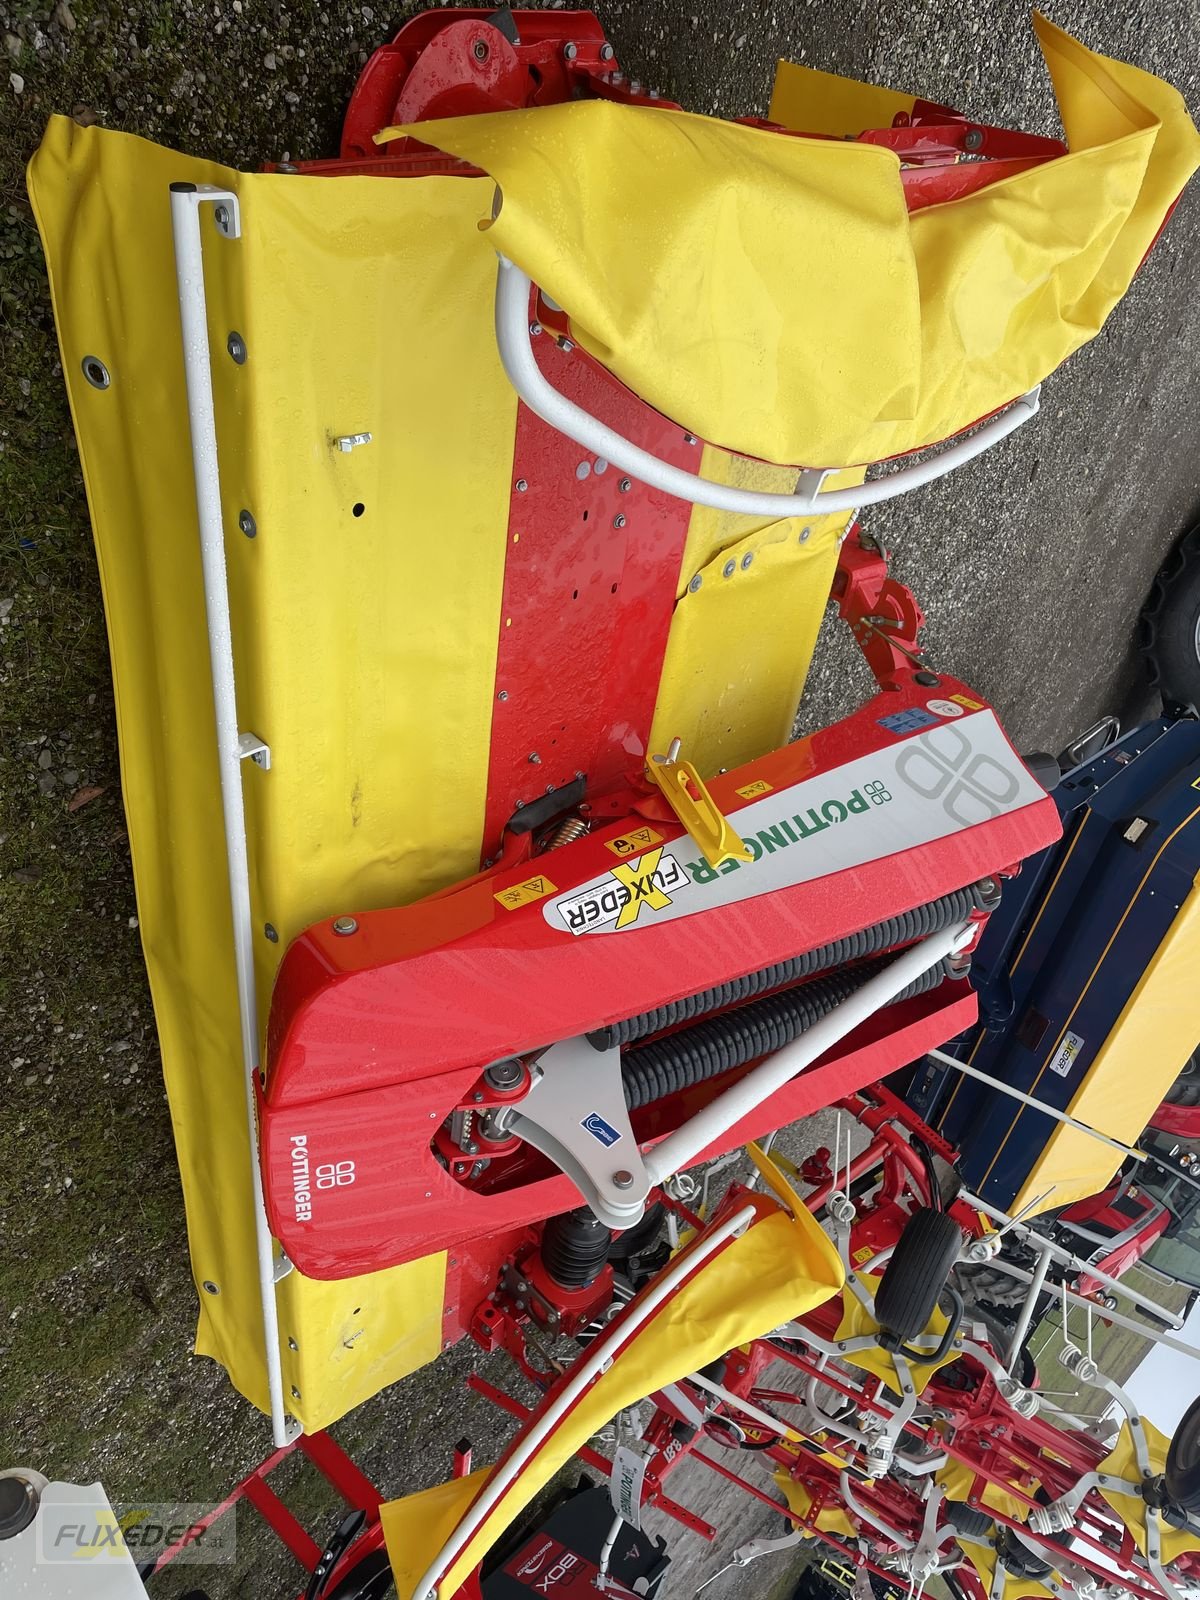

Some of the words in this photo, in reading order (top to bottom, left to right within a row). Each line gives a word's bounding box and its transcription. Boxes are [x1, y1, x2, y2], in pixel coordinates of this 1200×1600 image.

[566, 863, 680, 929] FLIXEDER
[290, 1135, 313, 1223] PÖTTINGER
[535, 1553, 578, 1592] BOX
